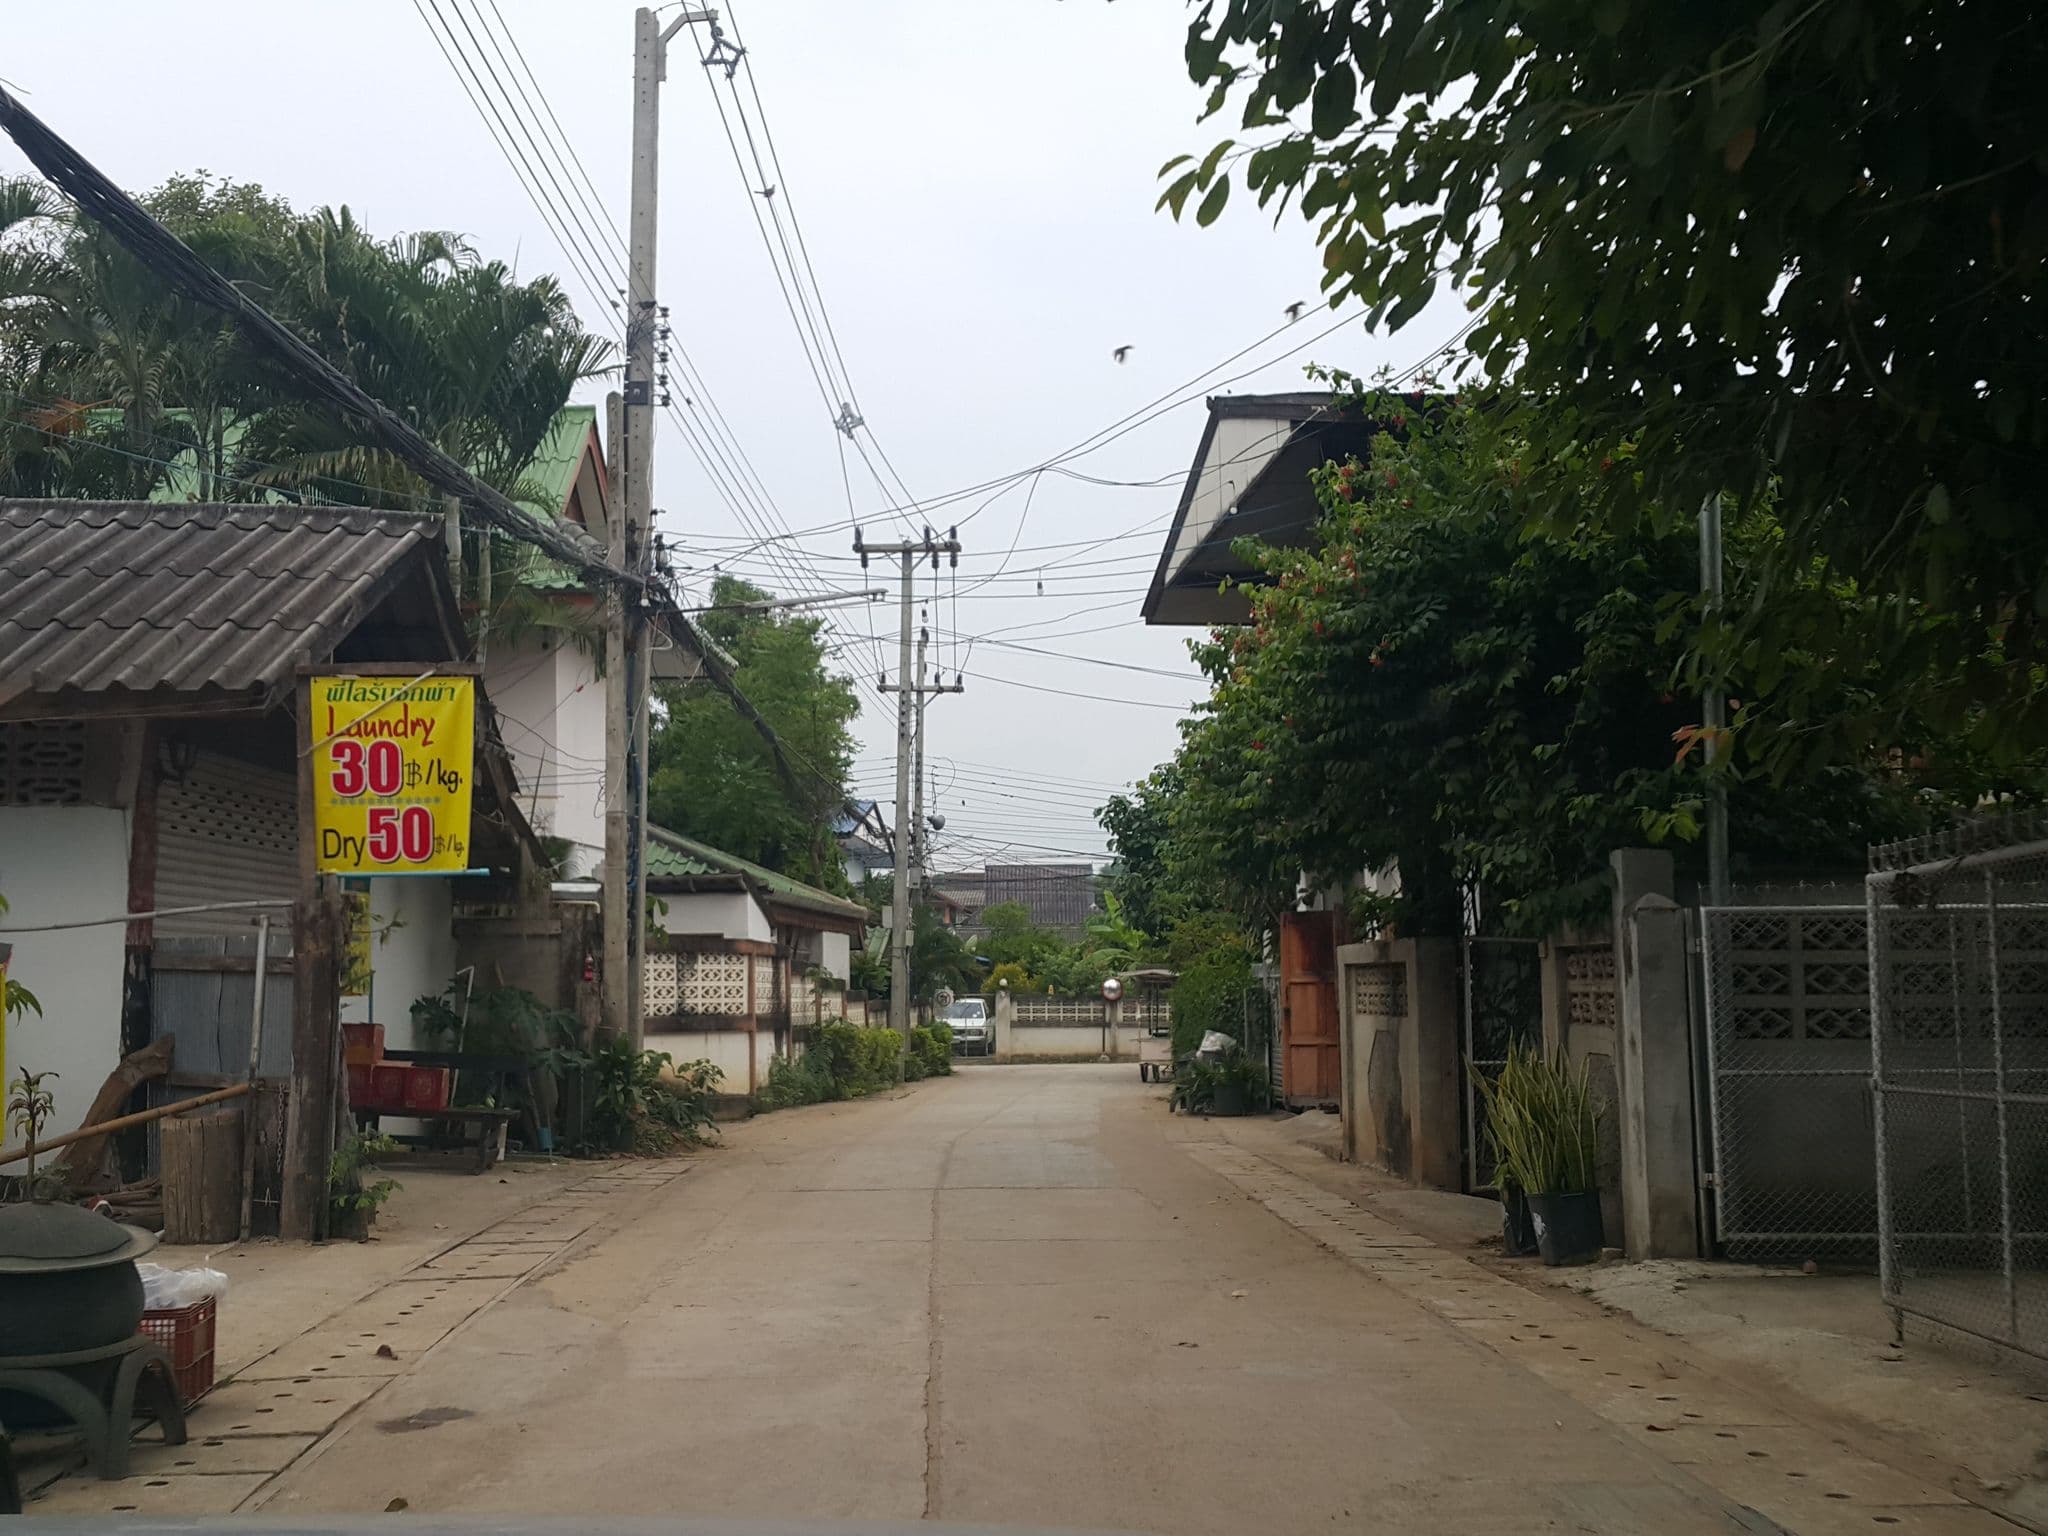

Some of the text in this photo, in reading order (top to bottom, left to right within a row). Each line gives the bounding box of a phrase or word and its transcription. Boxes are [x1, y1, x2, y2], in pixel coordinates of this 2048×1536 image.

[326, 703, 436, 746] Laundry
[331, 739, 403, 797] 30
[323, 829, 366, 866] Dry
[368, 806, 434, 864] 50
